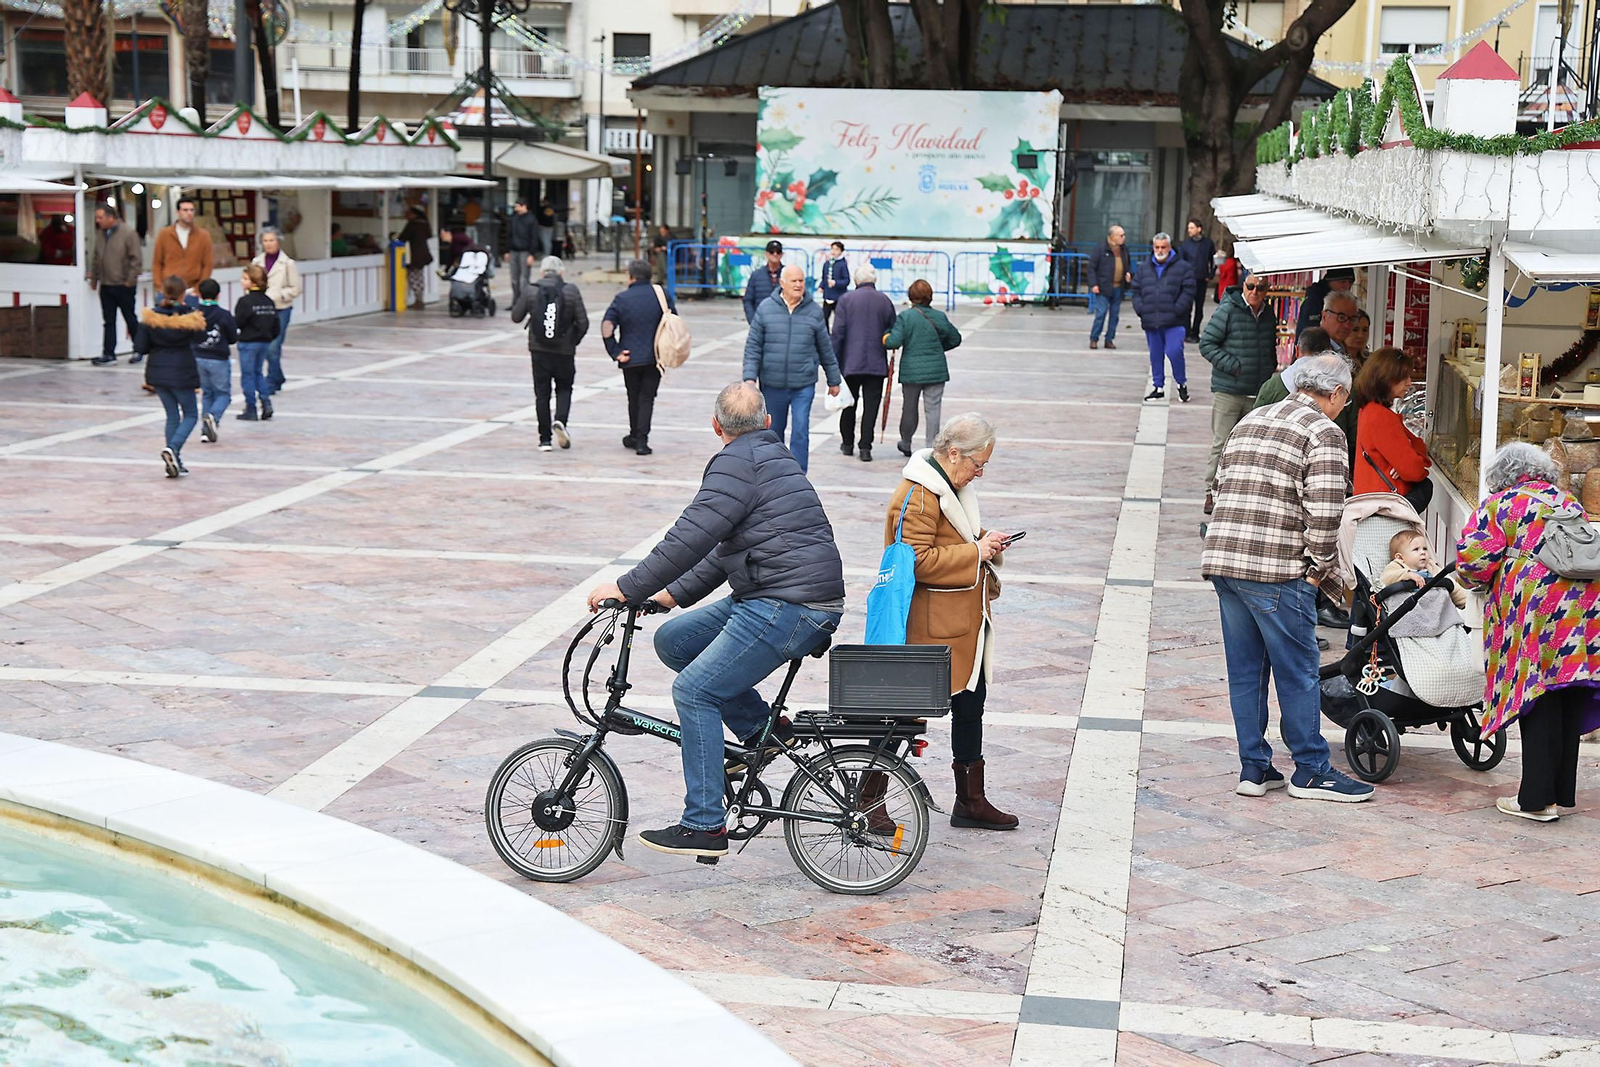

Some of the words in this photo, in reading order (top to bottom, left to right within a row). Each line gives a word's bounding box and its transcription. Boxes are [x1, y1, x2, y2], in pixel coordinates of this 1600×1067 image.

[830, 120, 880, 160] Feliz
[887, 123, 987, 150] Navidad
[938, 183, 969, 191] HUELVA
[543, 302, 556, 338] adidas
